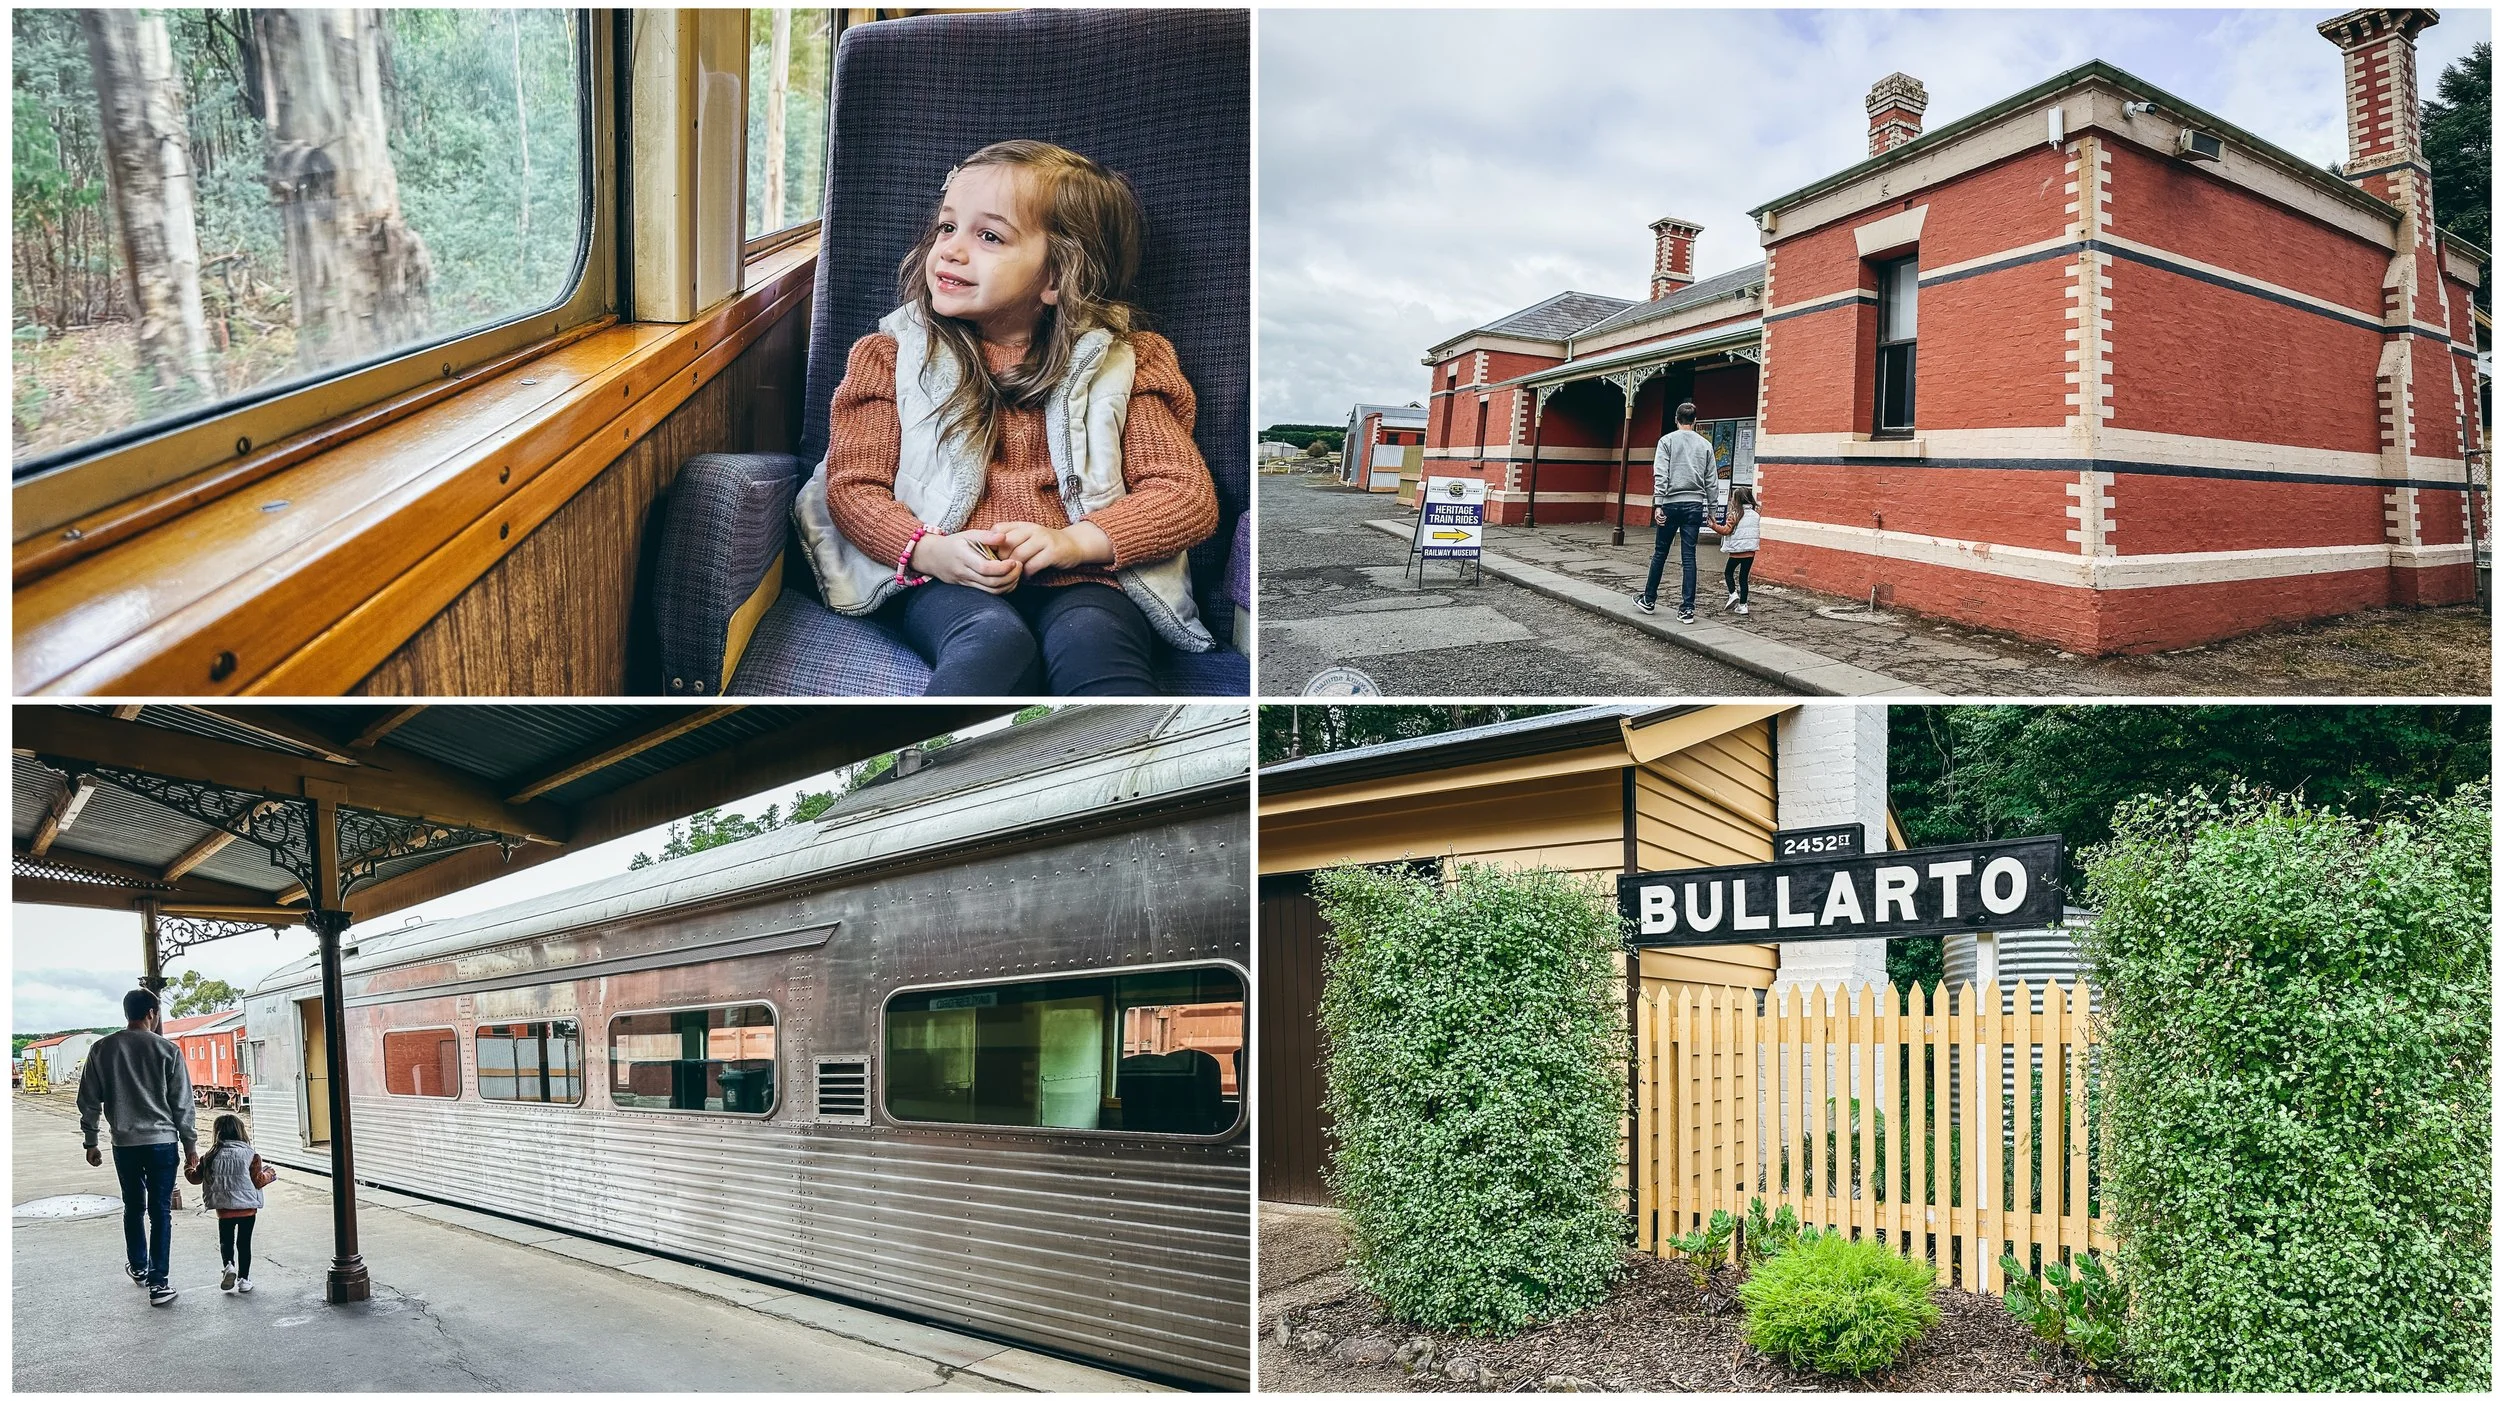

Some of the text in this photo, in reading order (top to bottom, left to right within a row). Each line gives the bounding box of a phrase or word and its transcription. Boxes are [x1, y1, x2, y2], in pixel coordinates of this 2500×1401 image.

[1436, 505, 1474, 515] HERITAGE
[1429, 514, 1479, 525] TRAIN RIDES
[1424, 548, 1479, 557] RAILWAY MUSEUM
[1639, 856, 2029, 935] BULLARTO
